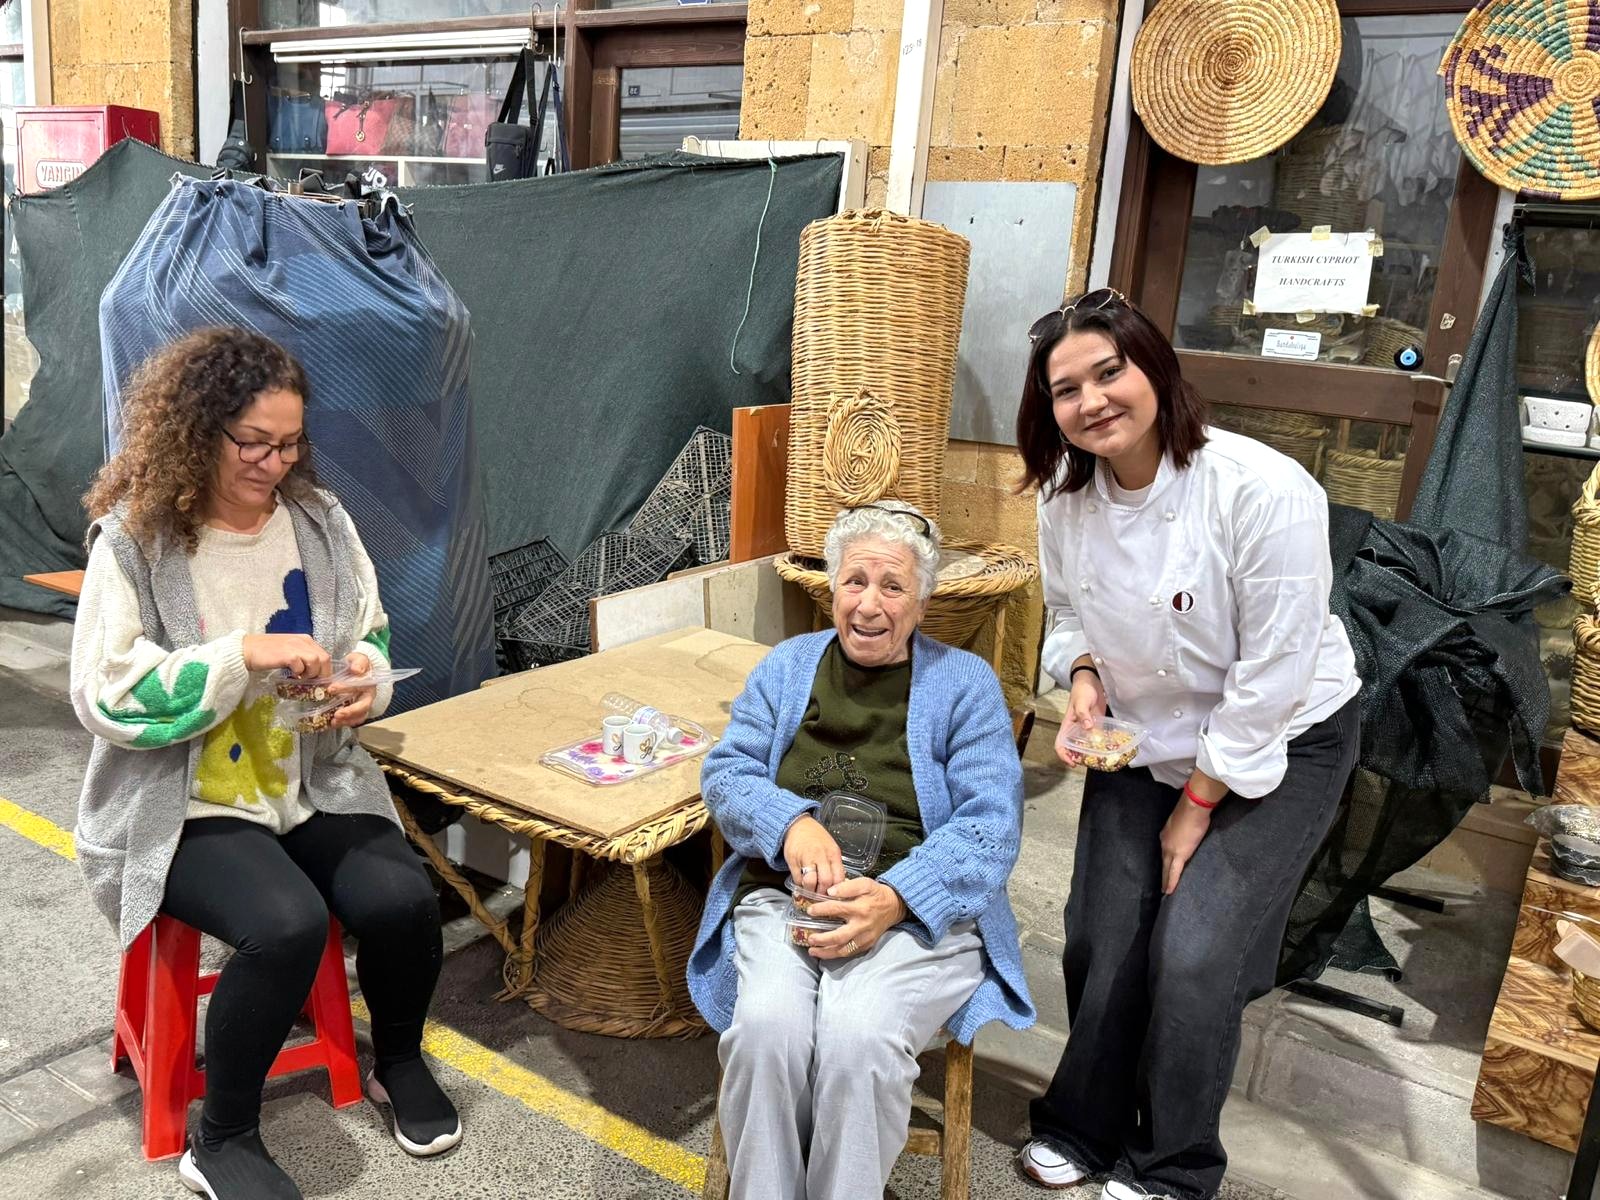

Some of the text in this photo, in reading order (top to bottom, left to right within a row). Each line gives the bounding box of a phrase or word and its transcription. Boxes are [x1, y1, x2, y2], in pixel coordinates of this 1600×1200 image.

[1272, 255, 1360, 264] TURKISH CYPRIOT
[1279, 278, 1346, 286] HANDCRAFTS
